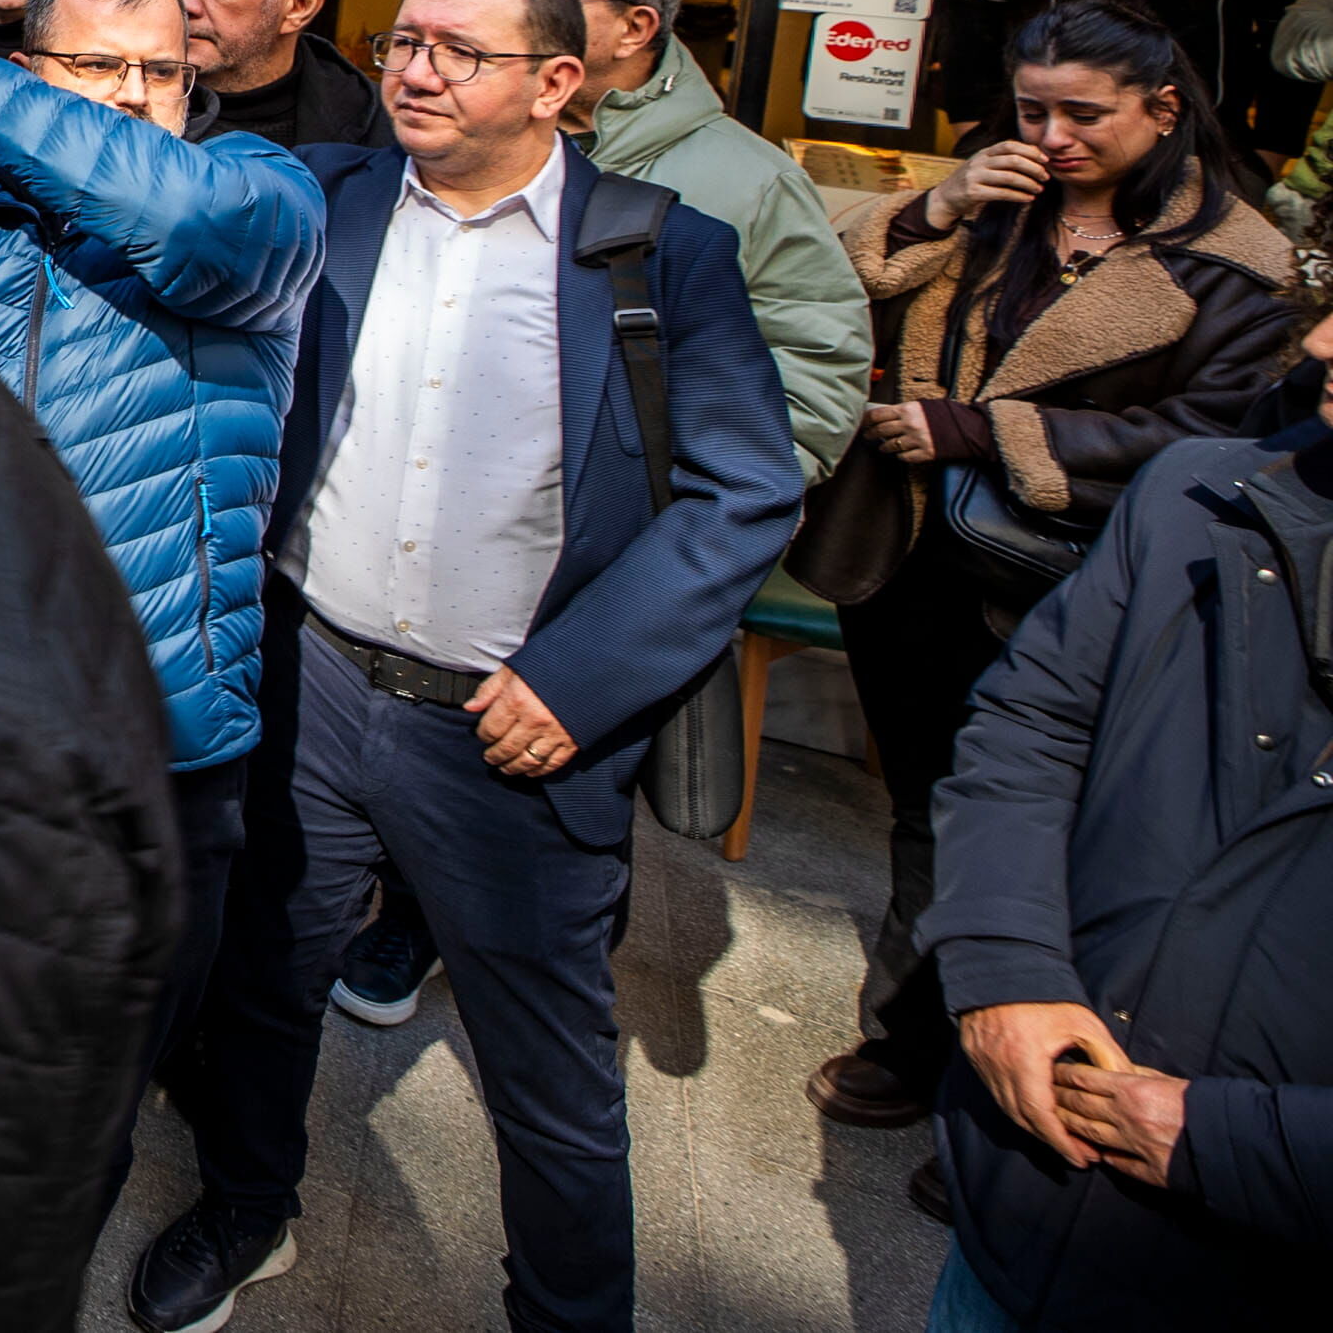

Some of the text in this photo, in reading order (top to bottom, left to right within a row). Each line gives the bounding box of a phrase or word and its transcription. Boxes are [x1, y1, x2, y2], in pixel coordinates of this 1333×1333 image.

[826, 30, 912, 52] Edenred
[839, 72, 905, 87] Restaurant
[872, 66, 906, 78] Ticket
